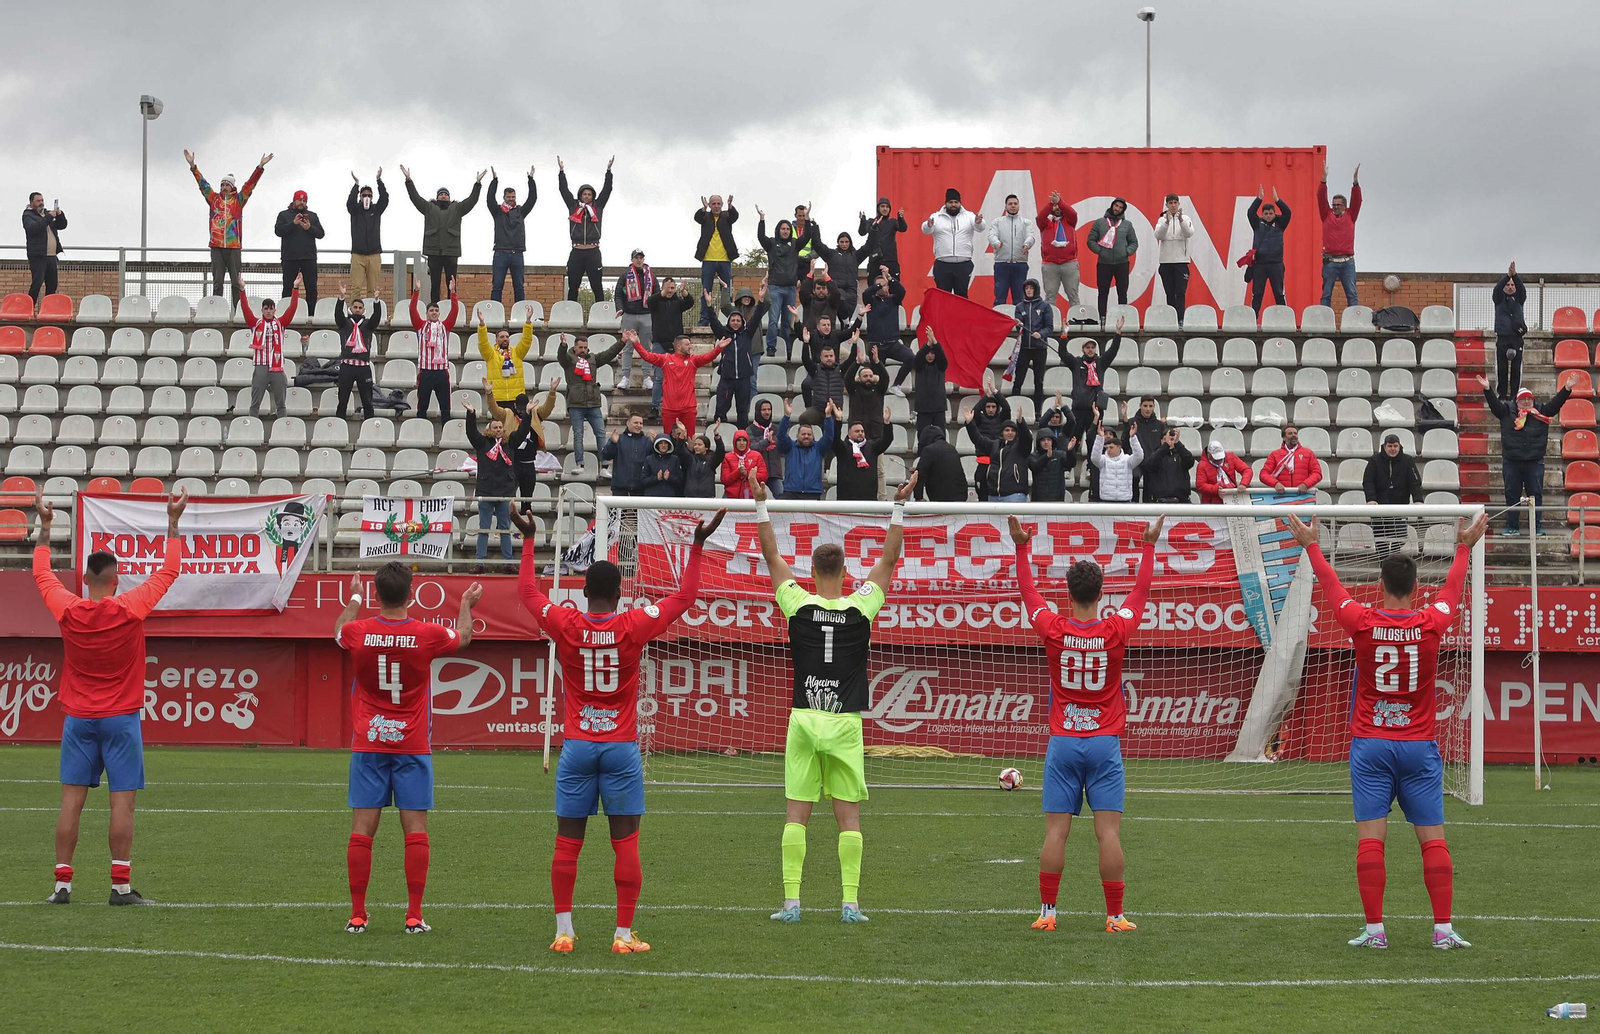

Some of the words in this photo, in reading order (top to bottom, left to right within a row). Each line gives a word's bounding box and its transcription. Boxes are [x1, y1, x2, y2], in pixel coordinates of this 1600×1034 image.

[373, 498, 395, 512] ACF
[419, 498, 447, 513] FANS
[369, 522, 383, 530] 19
[430, 523, 444, 531] 12
[366, 542, 399, 557] BARRIO
[116, 561, 165, 575] ENT
[181, 562, 261, 575] NUEVA
[929, 580, 965, 591] ACF
[315, 580, 446, 610] FUEO
[617, 595, 774, 628] ECCER
[812, 609, 847, 624] MARCOS
[363, 633, 395, 648] BORJA
[395, 635, 419, 649] FDEZ.
[582, 629, 590, 643] Y.
[591, 631, 615, 645] DIORI
[821, 625, 834, 663] 1
[512, 658, 748, 695] HDAI
[1375, 644, 1419, 692] 21
[377, 654, 403, 705] 4
[803, 674, 840, 693] Algeciras
[140, 689, 216, 728] Rojo
[937, 687, 1035, 721] matra
[1142, 690, 1241, 724] matra
